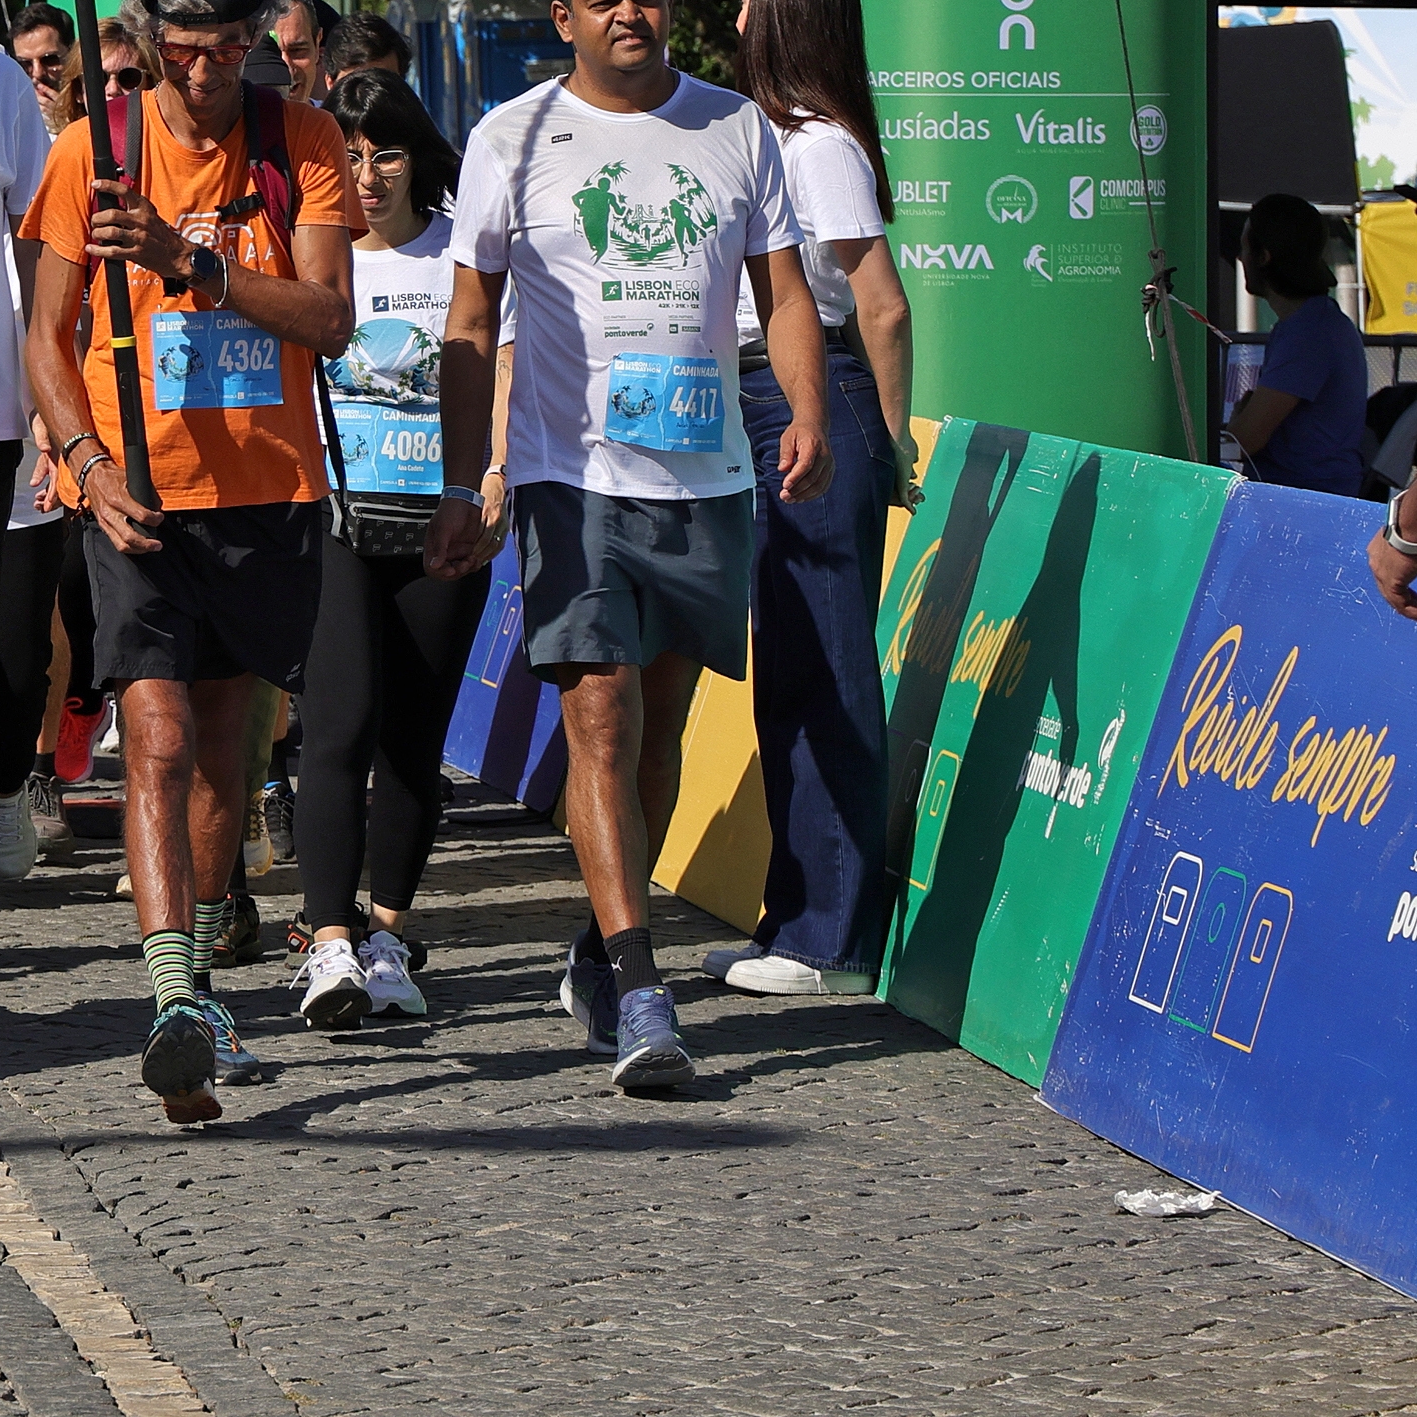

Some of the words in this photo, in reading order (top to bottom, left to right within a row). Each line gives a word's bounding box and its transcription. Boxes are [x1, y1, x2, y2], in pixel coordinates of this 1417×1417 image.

[867, 71, 964, 88] ARCEIROS
[971, 71, 1061, 88] OFICIAIS
[1016, 109, 1106, 144] Vitalis
[1058, 243, 1122, 253] INSTITUTO
[1058, 254, 1109, 264] SUPERIOR
[1058, 266, 1121, 275] AGRONOMIA
[625, 281, 672, 290] LISBON
[676, 280, 699, 290] ECO
[392, 293, 431, 302] LISBON
[626, 291, 699, 301] MARATHON
[605, 330, 647, 338] pontoverde
[217, 338, 275, 372] 4362
[673, 365, 719, 378] CAMINHADA
[669, 386, 717, 418] 4417
[381, 430, 441, 462] 4086
[1157, 624, 1301, 800] Recicle
[1271, 714, 1398, 849] sempre
